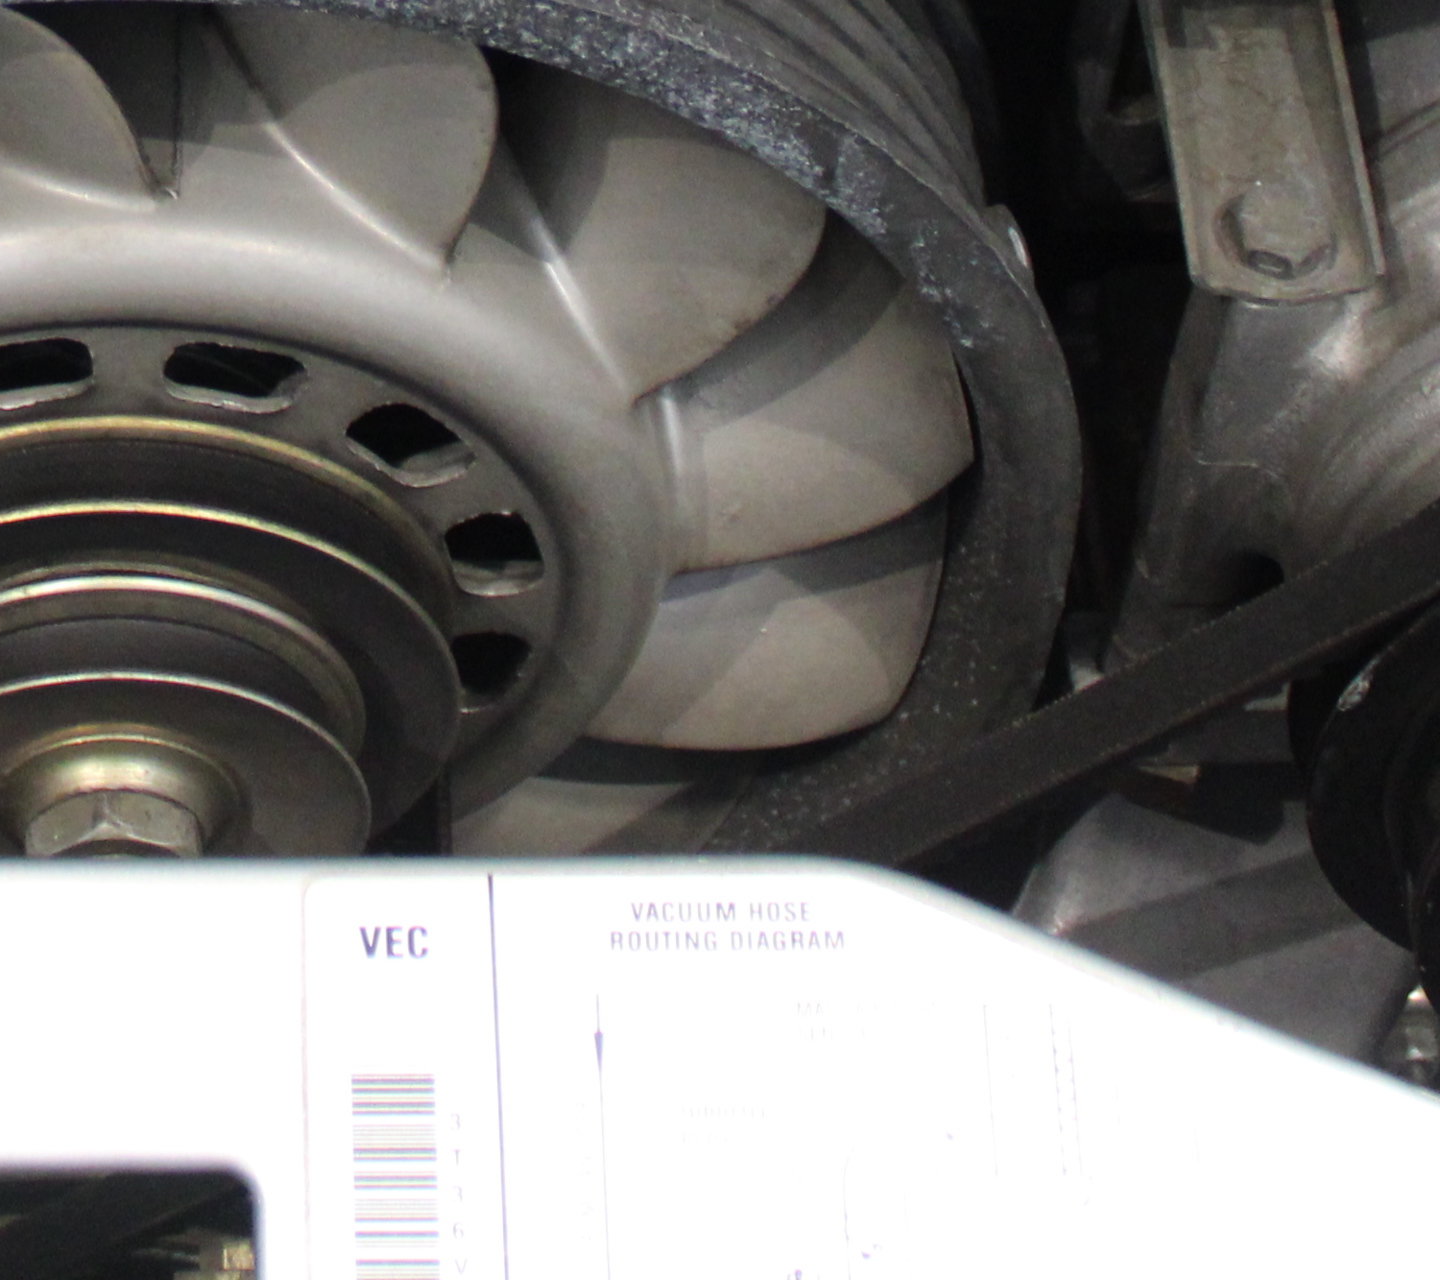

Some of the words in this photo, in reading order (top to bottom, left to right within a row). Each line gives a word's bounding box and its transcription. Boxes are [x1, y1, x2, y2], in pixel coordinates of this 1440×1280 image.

[631, 902, 736, 922] VACUUM
[749, 902, 808, 922] HOSE
[360, 926, 428, 958] VEC
[610, 931, 717, 951] ROUTING
[730, 930, 844, 951] DIAGRAM
